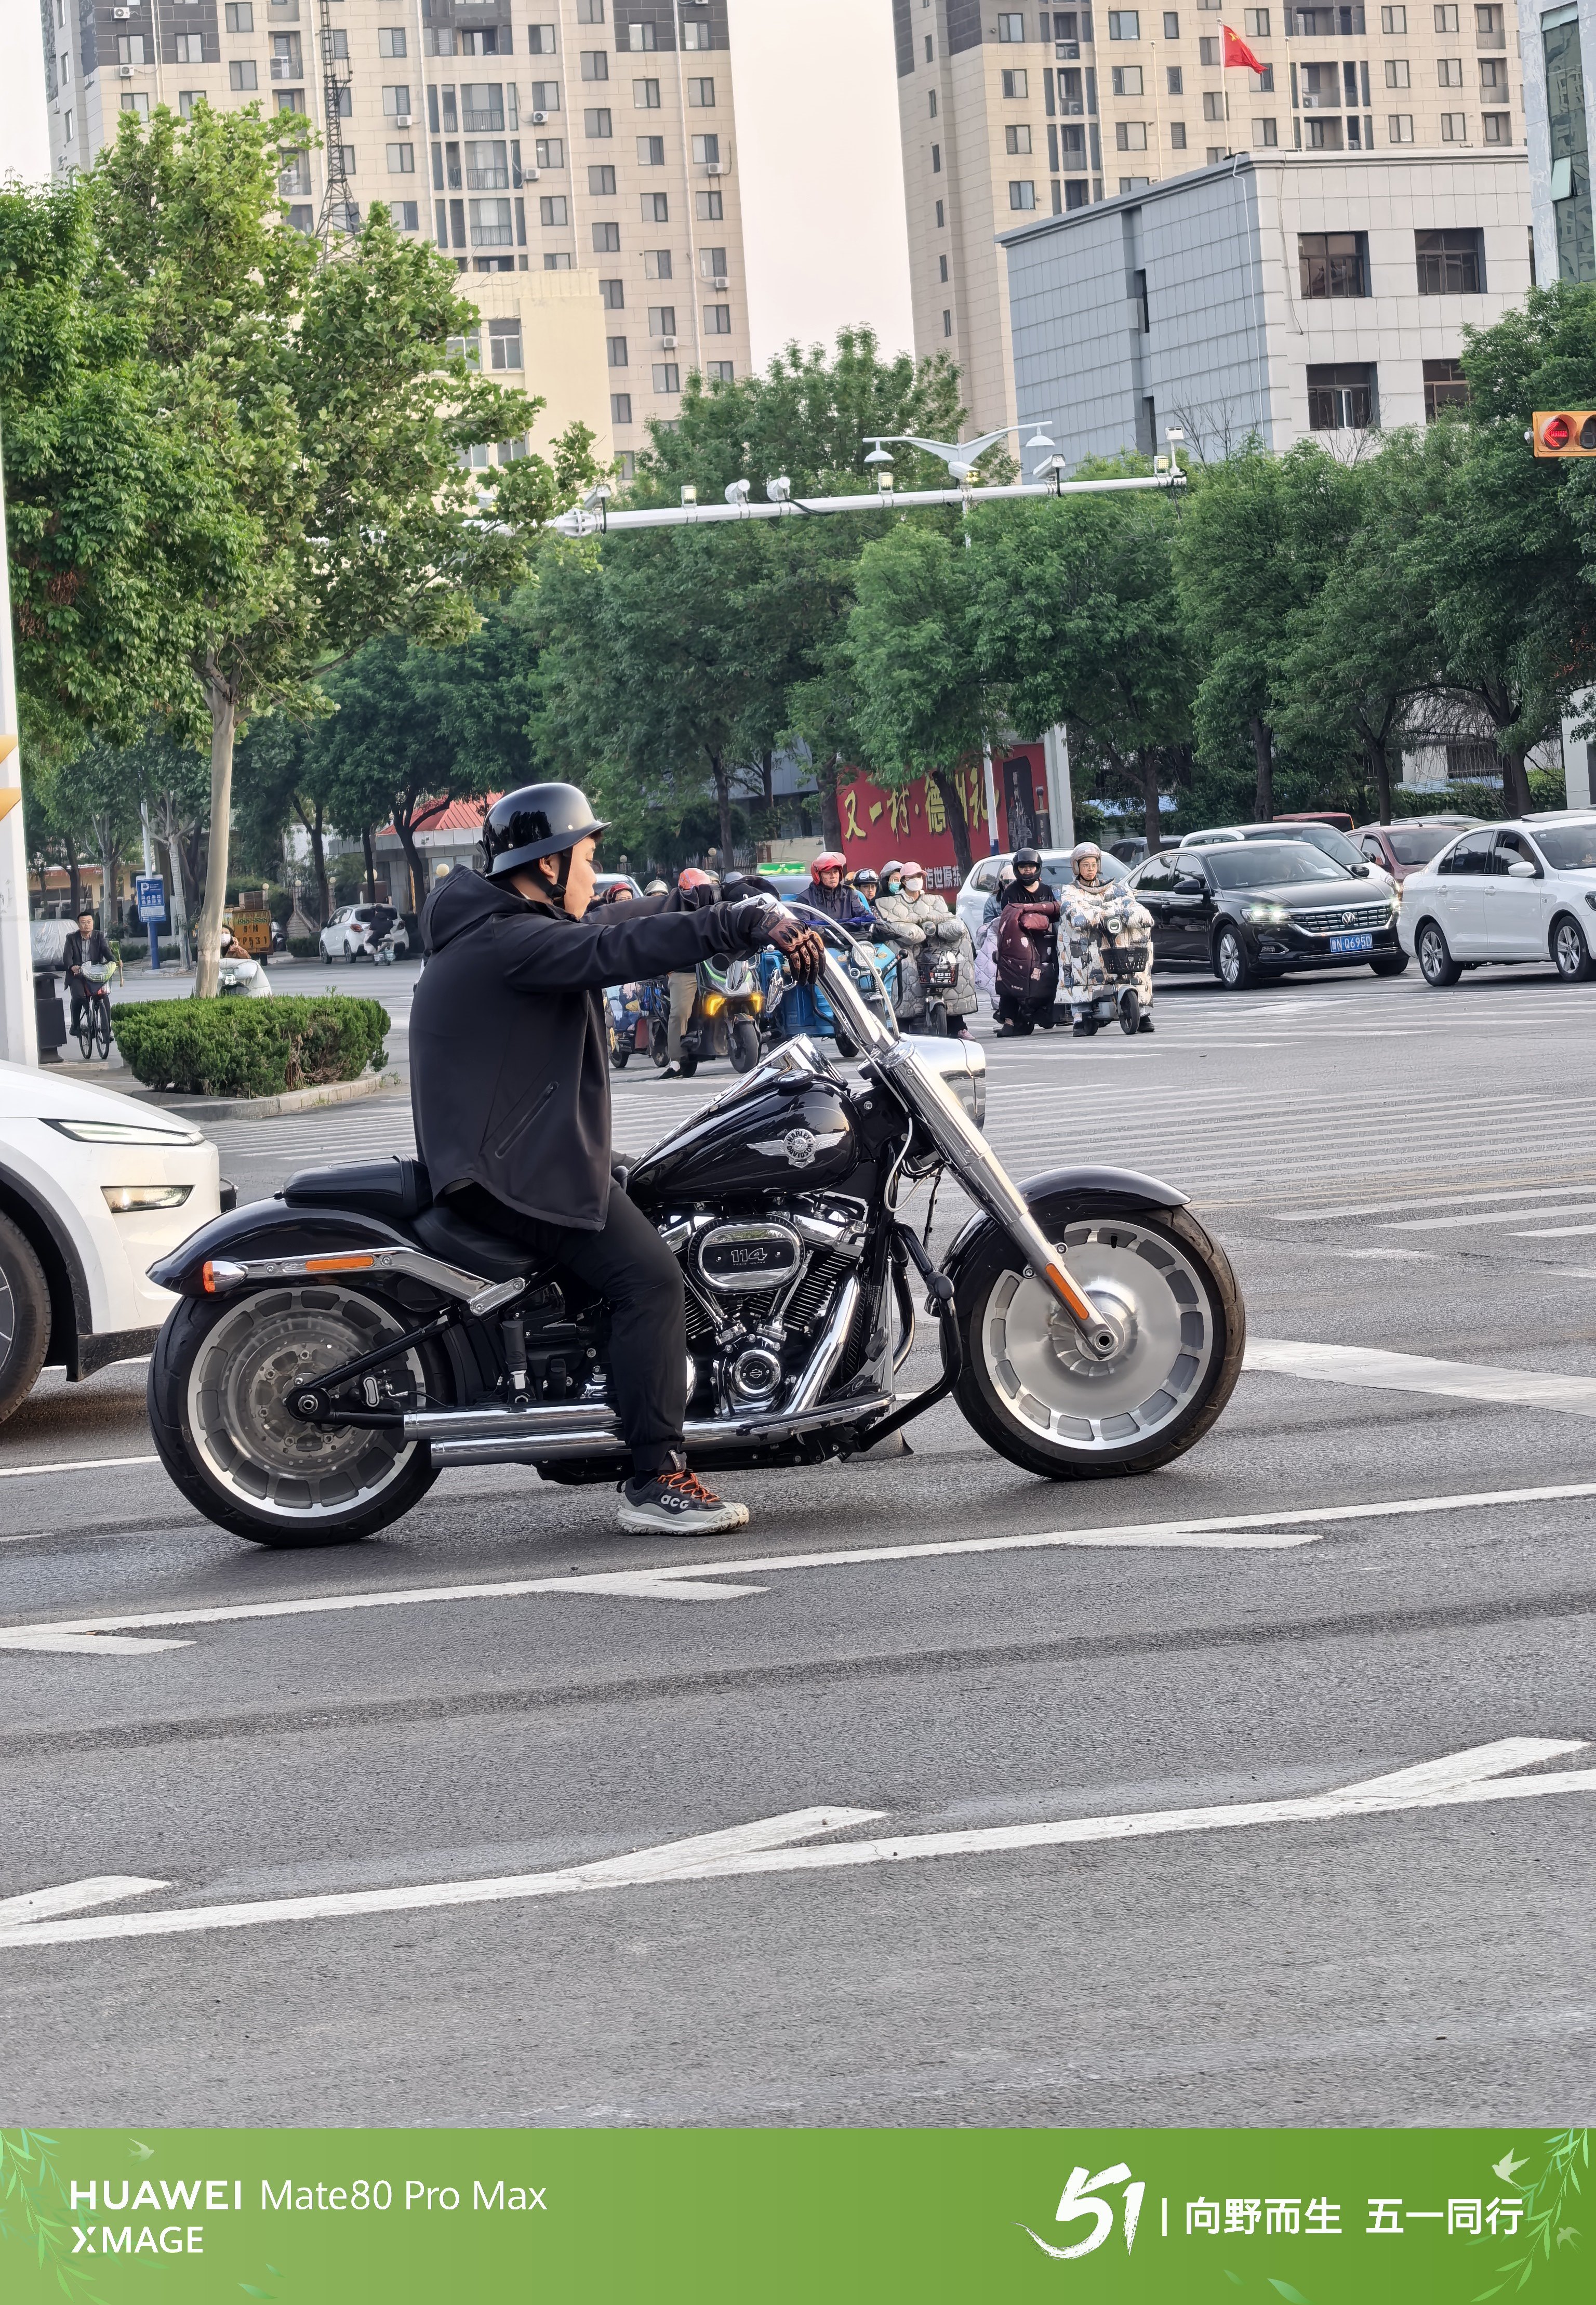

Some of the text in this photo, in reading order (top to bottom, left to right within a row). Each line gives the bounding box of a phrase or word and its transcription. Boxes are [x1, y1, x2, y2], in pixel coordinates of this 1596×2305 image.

[787, 1131, 812, 1143] HARLEY
[787, 1143, 813, 1158] DAVIDSON
[731, 1248, 768, 1263] 114
